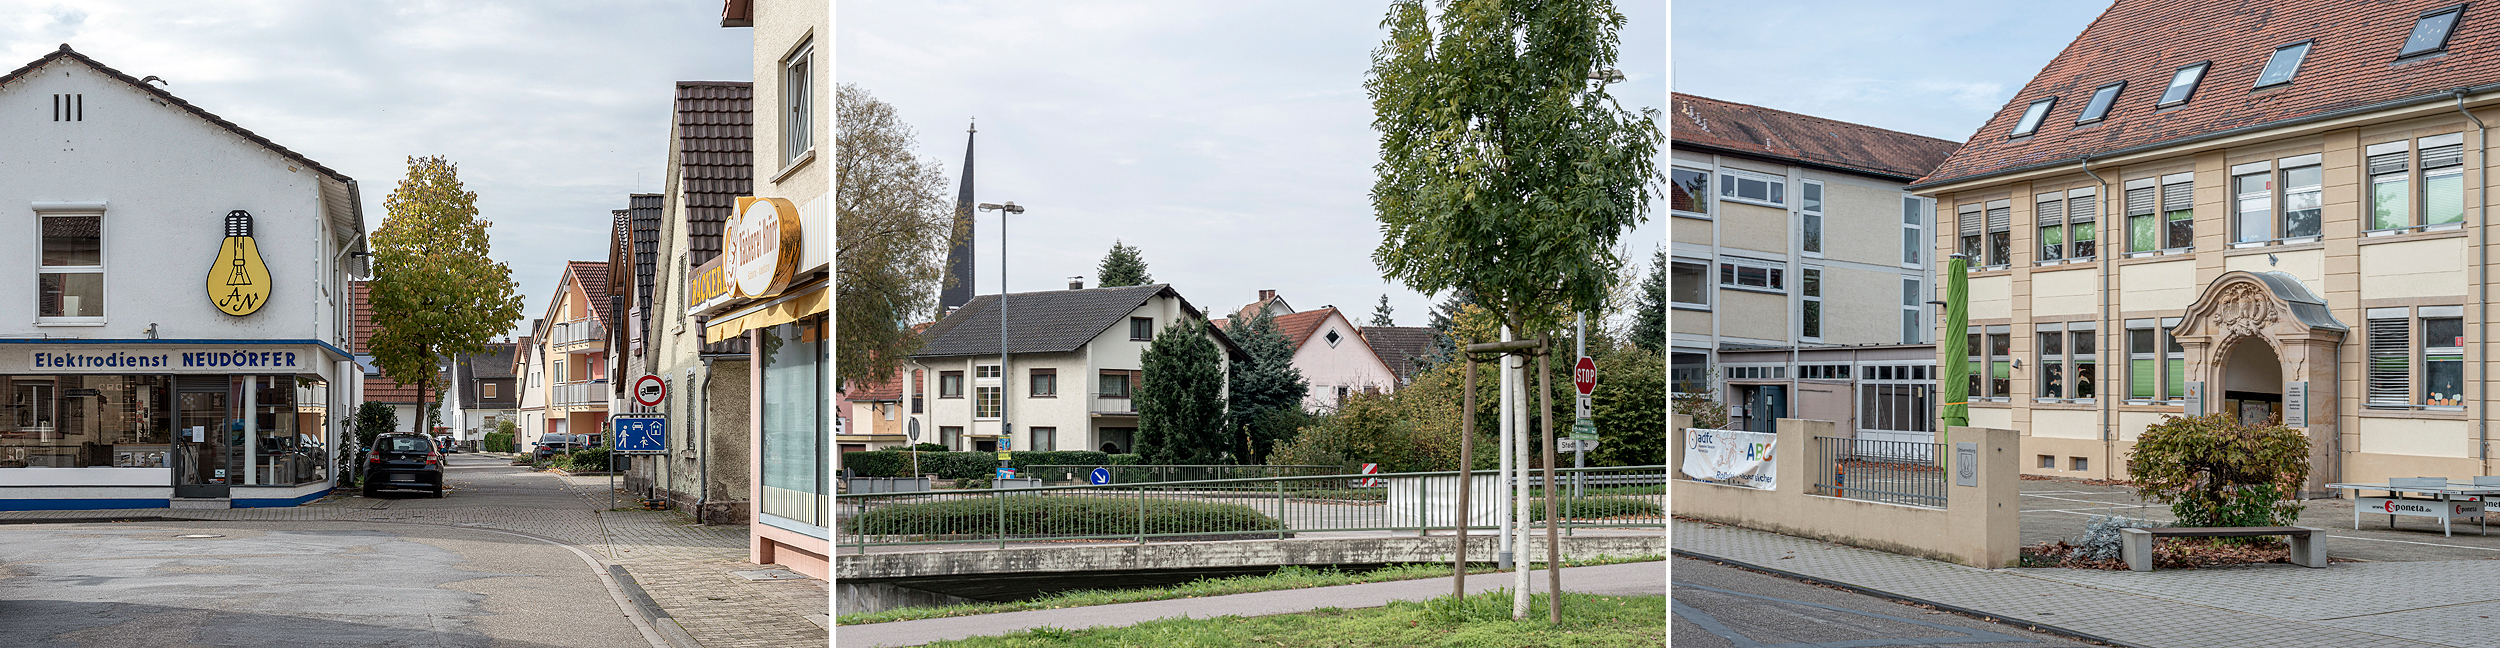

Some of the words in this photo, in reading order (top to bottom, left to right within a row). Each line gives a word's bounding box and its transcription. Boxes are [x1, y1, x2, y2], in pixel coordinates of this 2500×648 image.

[34, 352, 168, 367] Elektrodienst
[182, 350, 296, 367] NEUDÖRFER
[1577, 368, 1594, 384] STOP
[1697, 432, 1713, 444] adfc
